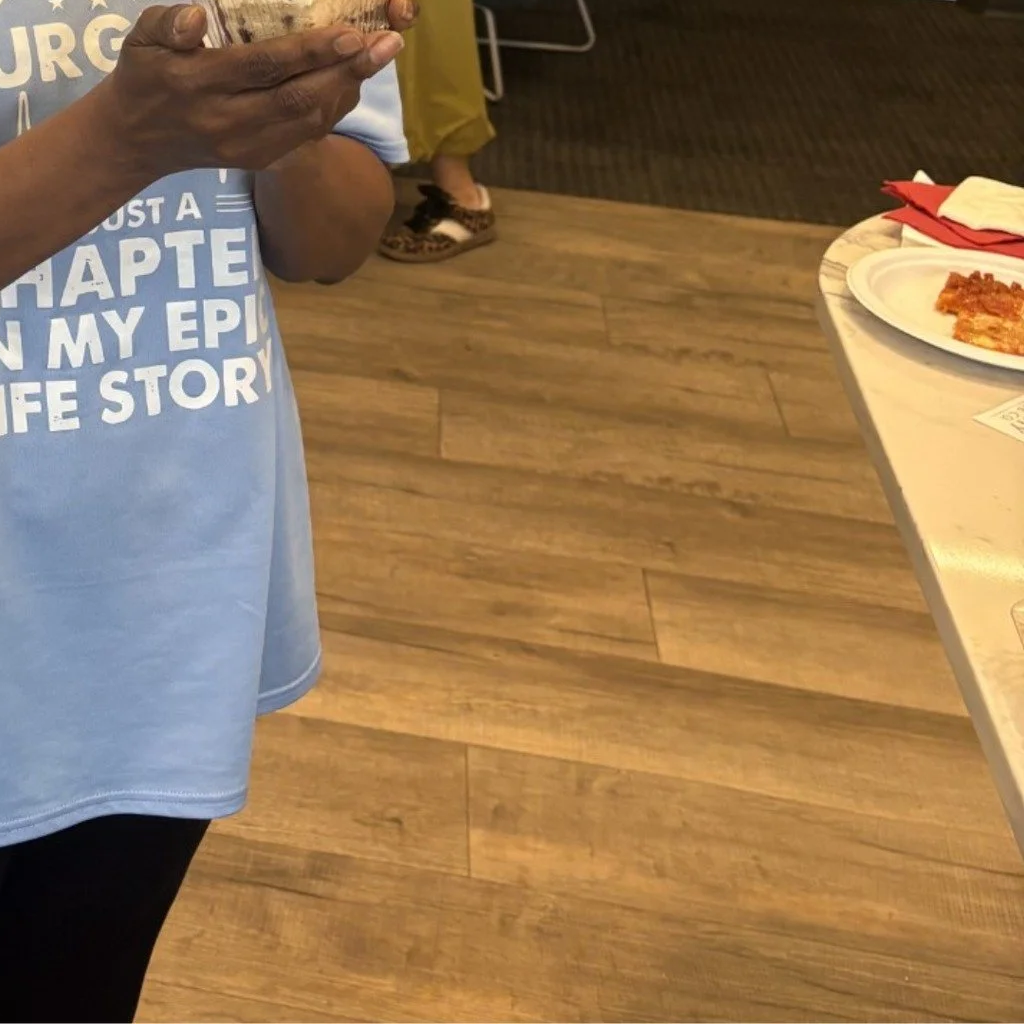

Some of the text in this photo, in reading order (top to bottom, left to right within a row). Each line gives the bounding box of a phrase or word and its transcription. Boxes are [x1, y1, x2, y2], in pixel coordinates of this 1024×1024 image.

[88, 192, 202, 234] UST A
[47, 306, 145, 369] MY
[99, 337, 273, 425] STORY
